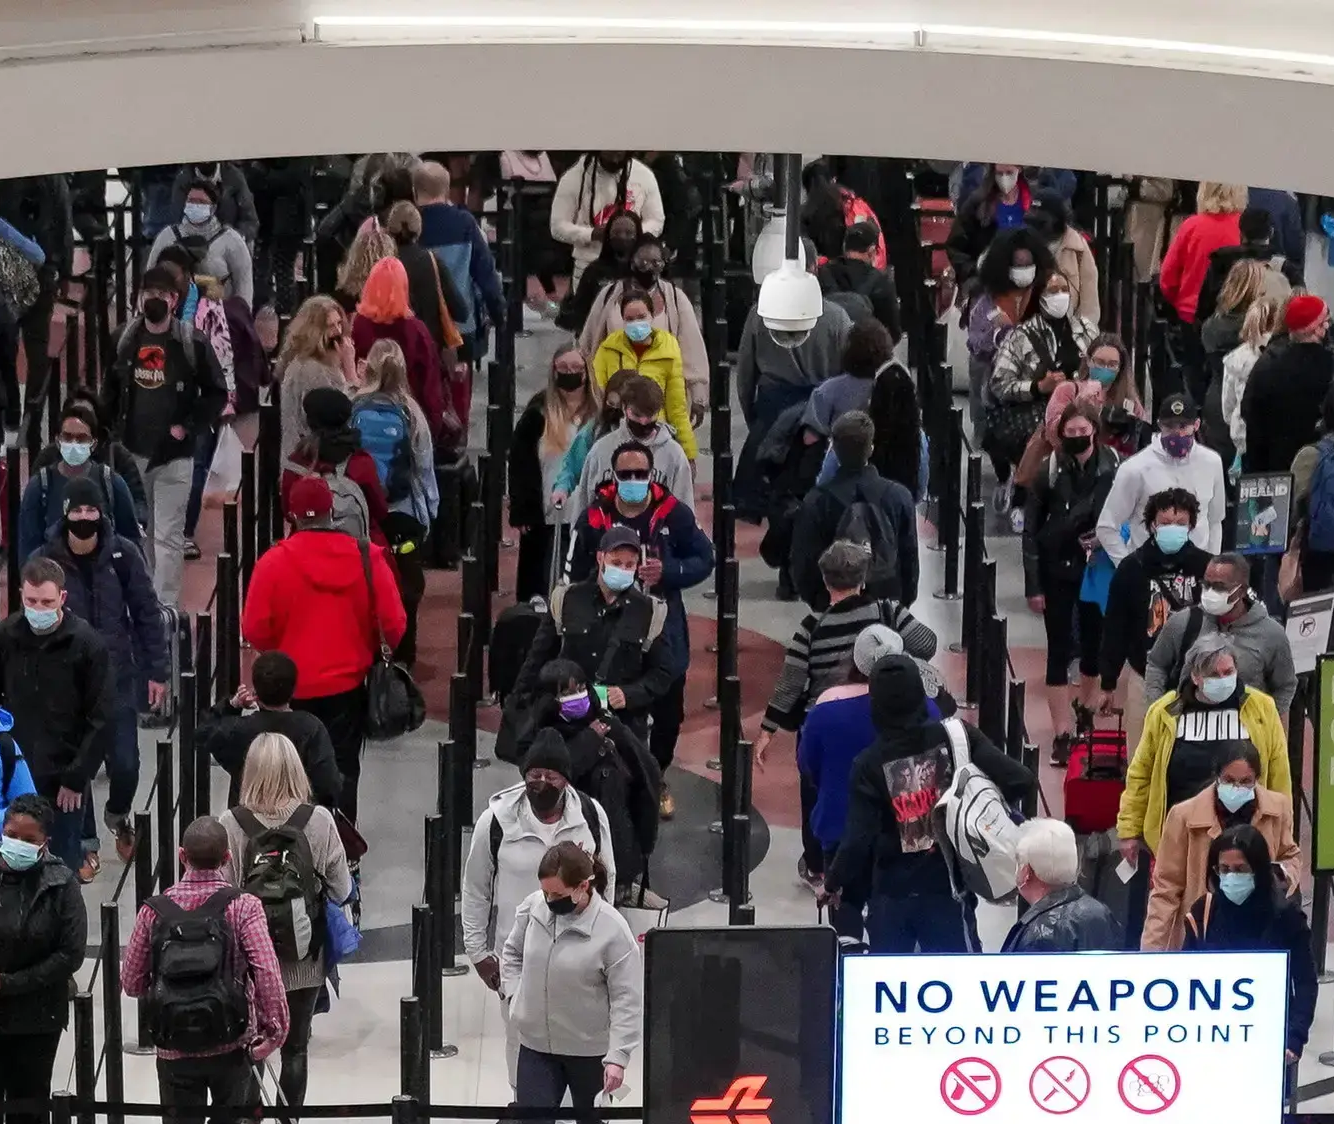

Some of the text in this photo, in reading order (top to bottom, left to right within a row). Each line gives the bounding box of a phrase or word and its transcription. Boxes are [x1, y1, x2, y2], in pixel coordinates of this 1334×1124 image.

[875, 978, 1255, 1013] NO WEAPONS
[875, 1024, 1255, 1045] BEYOND THIS POINT
